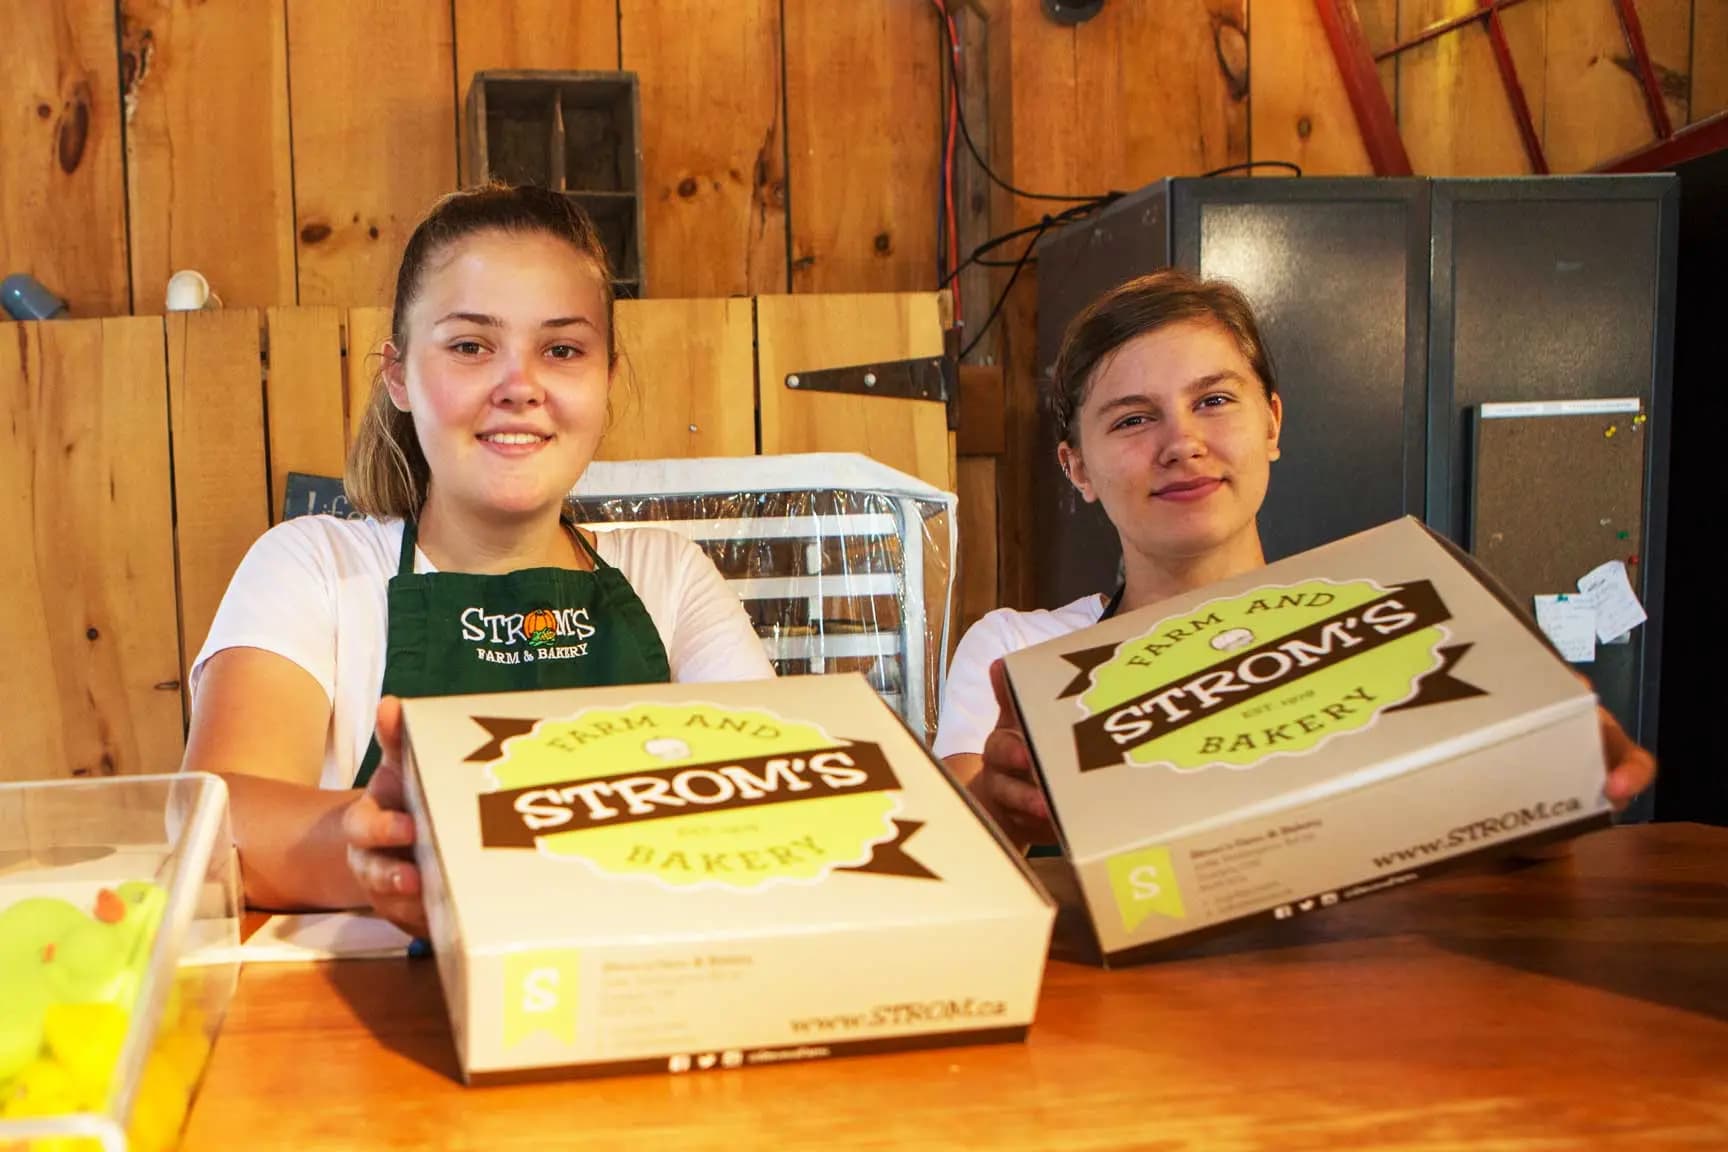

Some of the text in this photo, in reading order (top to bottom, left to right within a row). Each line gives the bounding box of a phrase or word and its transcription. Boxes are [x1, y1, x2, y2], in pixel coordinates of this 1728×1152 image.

[476, 642, 589, 665] FARM & BAKERY
[1127, 591, 1337, 668] FARM AND
[1102, 599, 1418, 745] STROM'S
[546, 713, 782, 753] FARM AND
[1198, 687, 1379, 755] BAKERY
[513, 751, 869, 829] STROM'S
[625, 834, 827, 874] BAKERY
[1372, 797, 1583, 868] www.STROM.ca
[1127, 865, 1161, 902] S
[521, 967, 562, 1013] S
